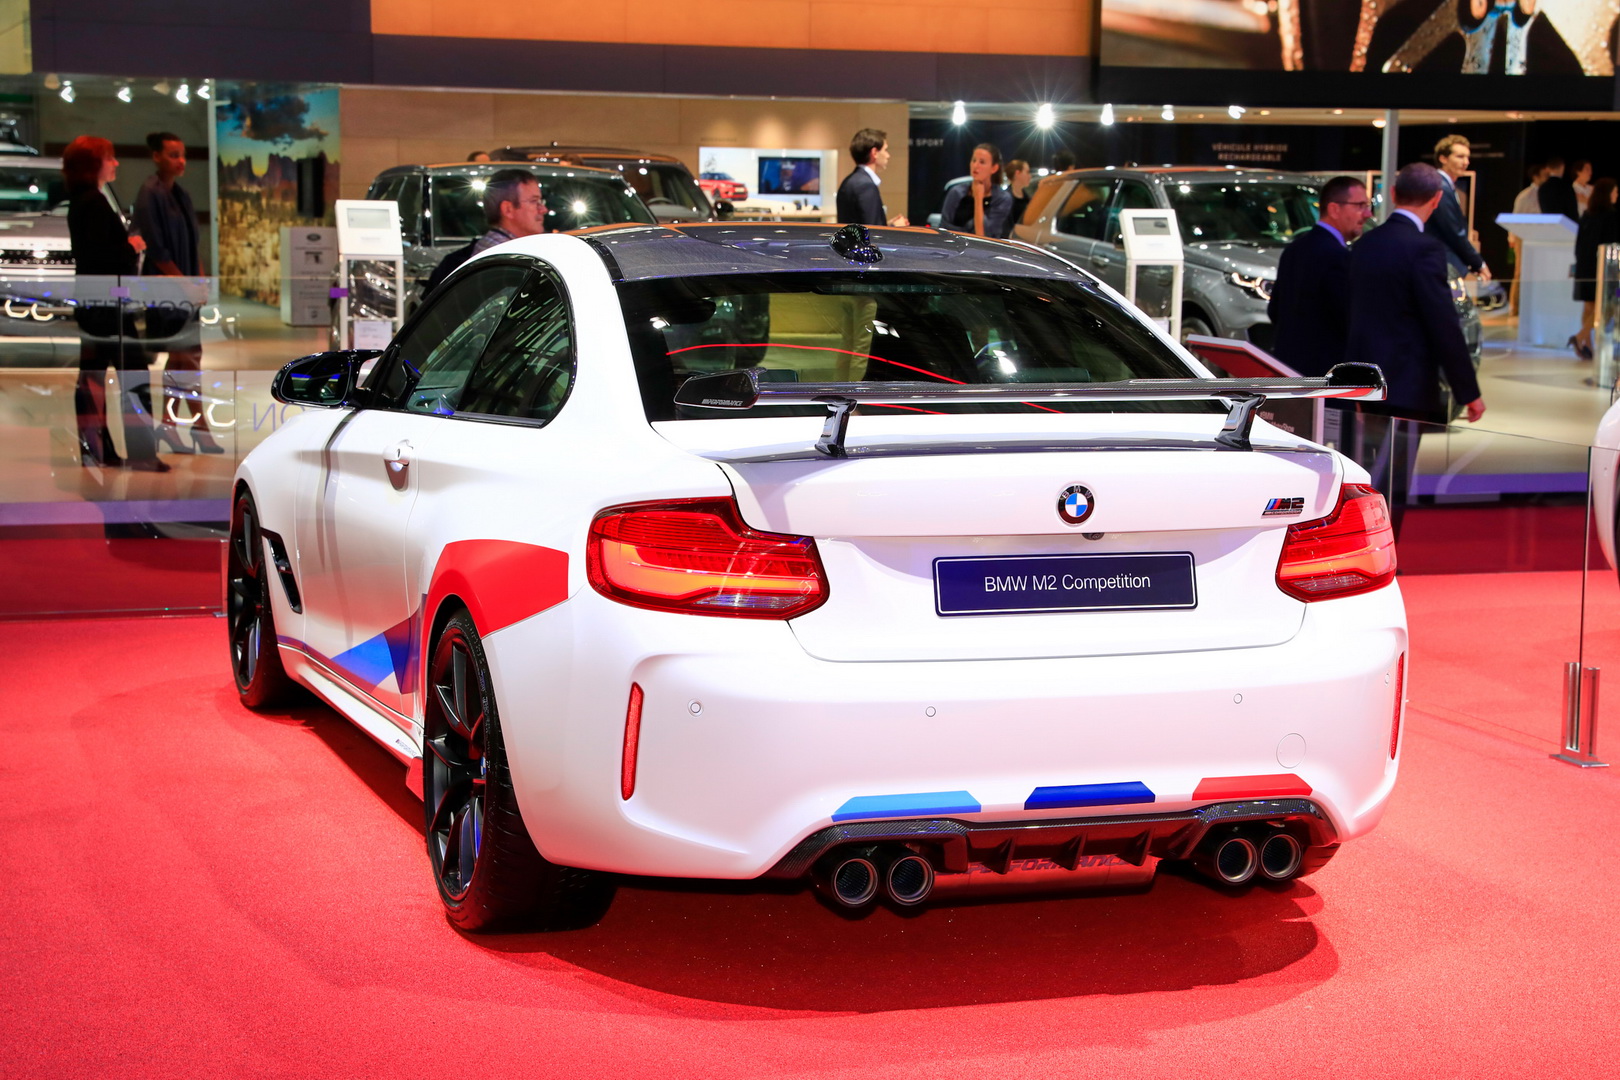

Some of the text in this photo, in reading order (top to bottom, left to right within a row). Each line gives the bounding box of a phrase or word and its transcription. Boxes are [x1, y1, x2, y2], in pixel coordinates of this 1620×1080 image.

[915, 138, 944, 147] SPORT
[1060, 485, 1093, 499] BMW
[984, 573, 1151, 592] BMW M2 Competition
